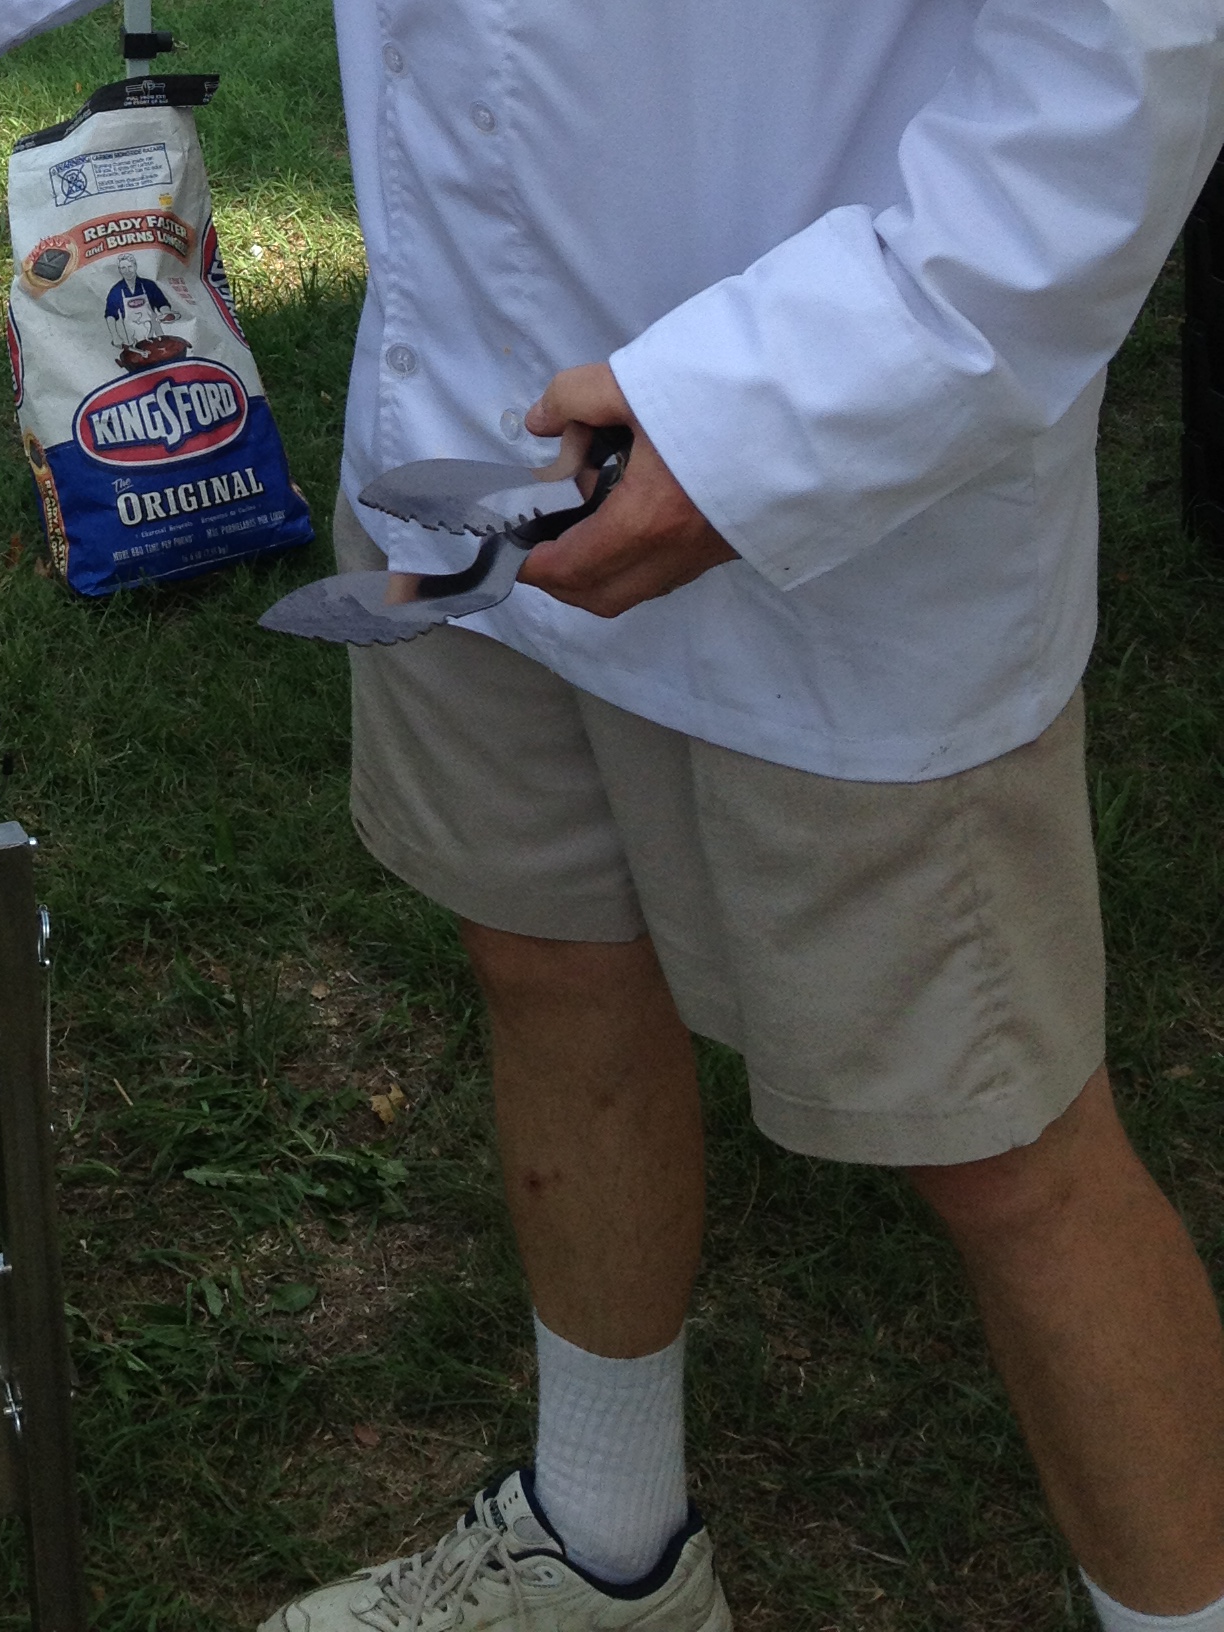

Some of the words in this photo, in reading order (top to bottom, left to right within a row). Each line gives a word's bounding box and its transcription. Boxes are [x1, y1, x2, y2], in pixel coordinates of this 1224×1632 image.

[83, 217, 143, 242] READY
[145, 215, 188, 237] FASTER
[85, 241, 104, 258] and
[106, 231, 155, 249] BURNS
[90, 380, 237, 446] KINGSFORD
[111, 477, 134, 493] The
[116, 467, 264, 526] ORIGINAL
